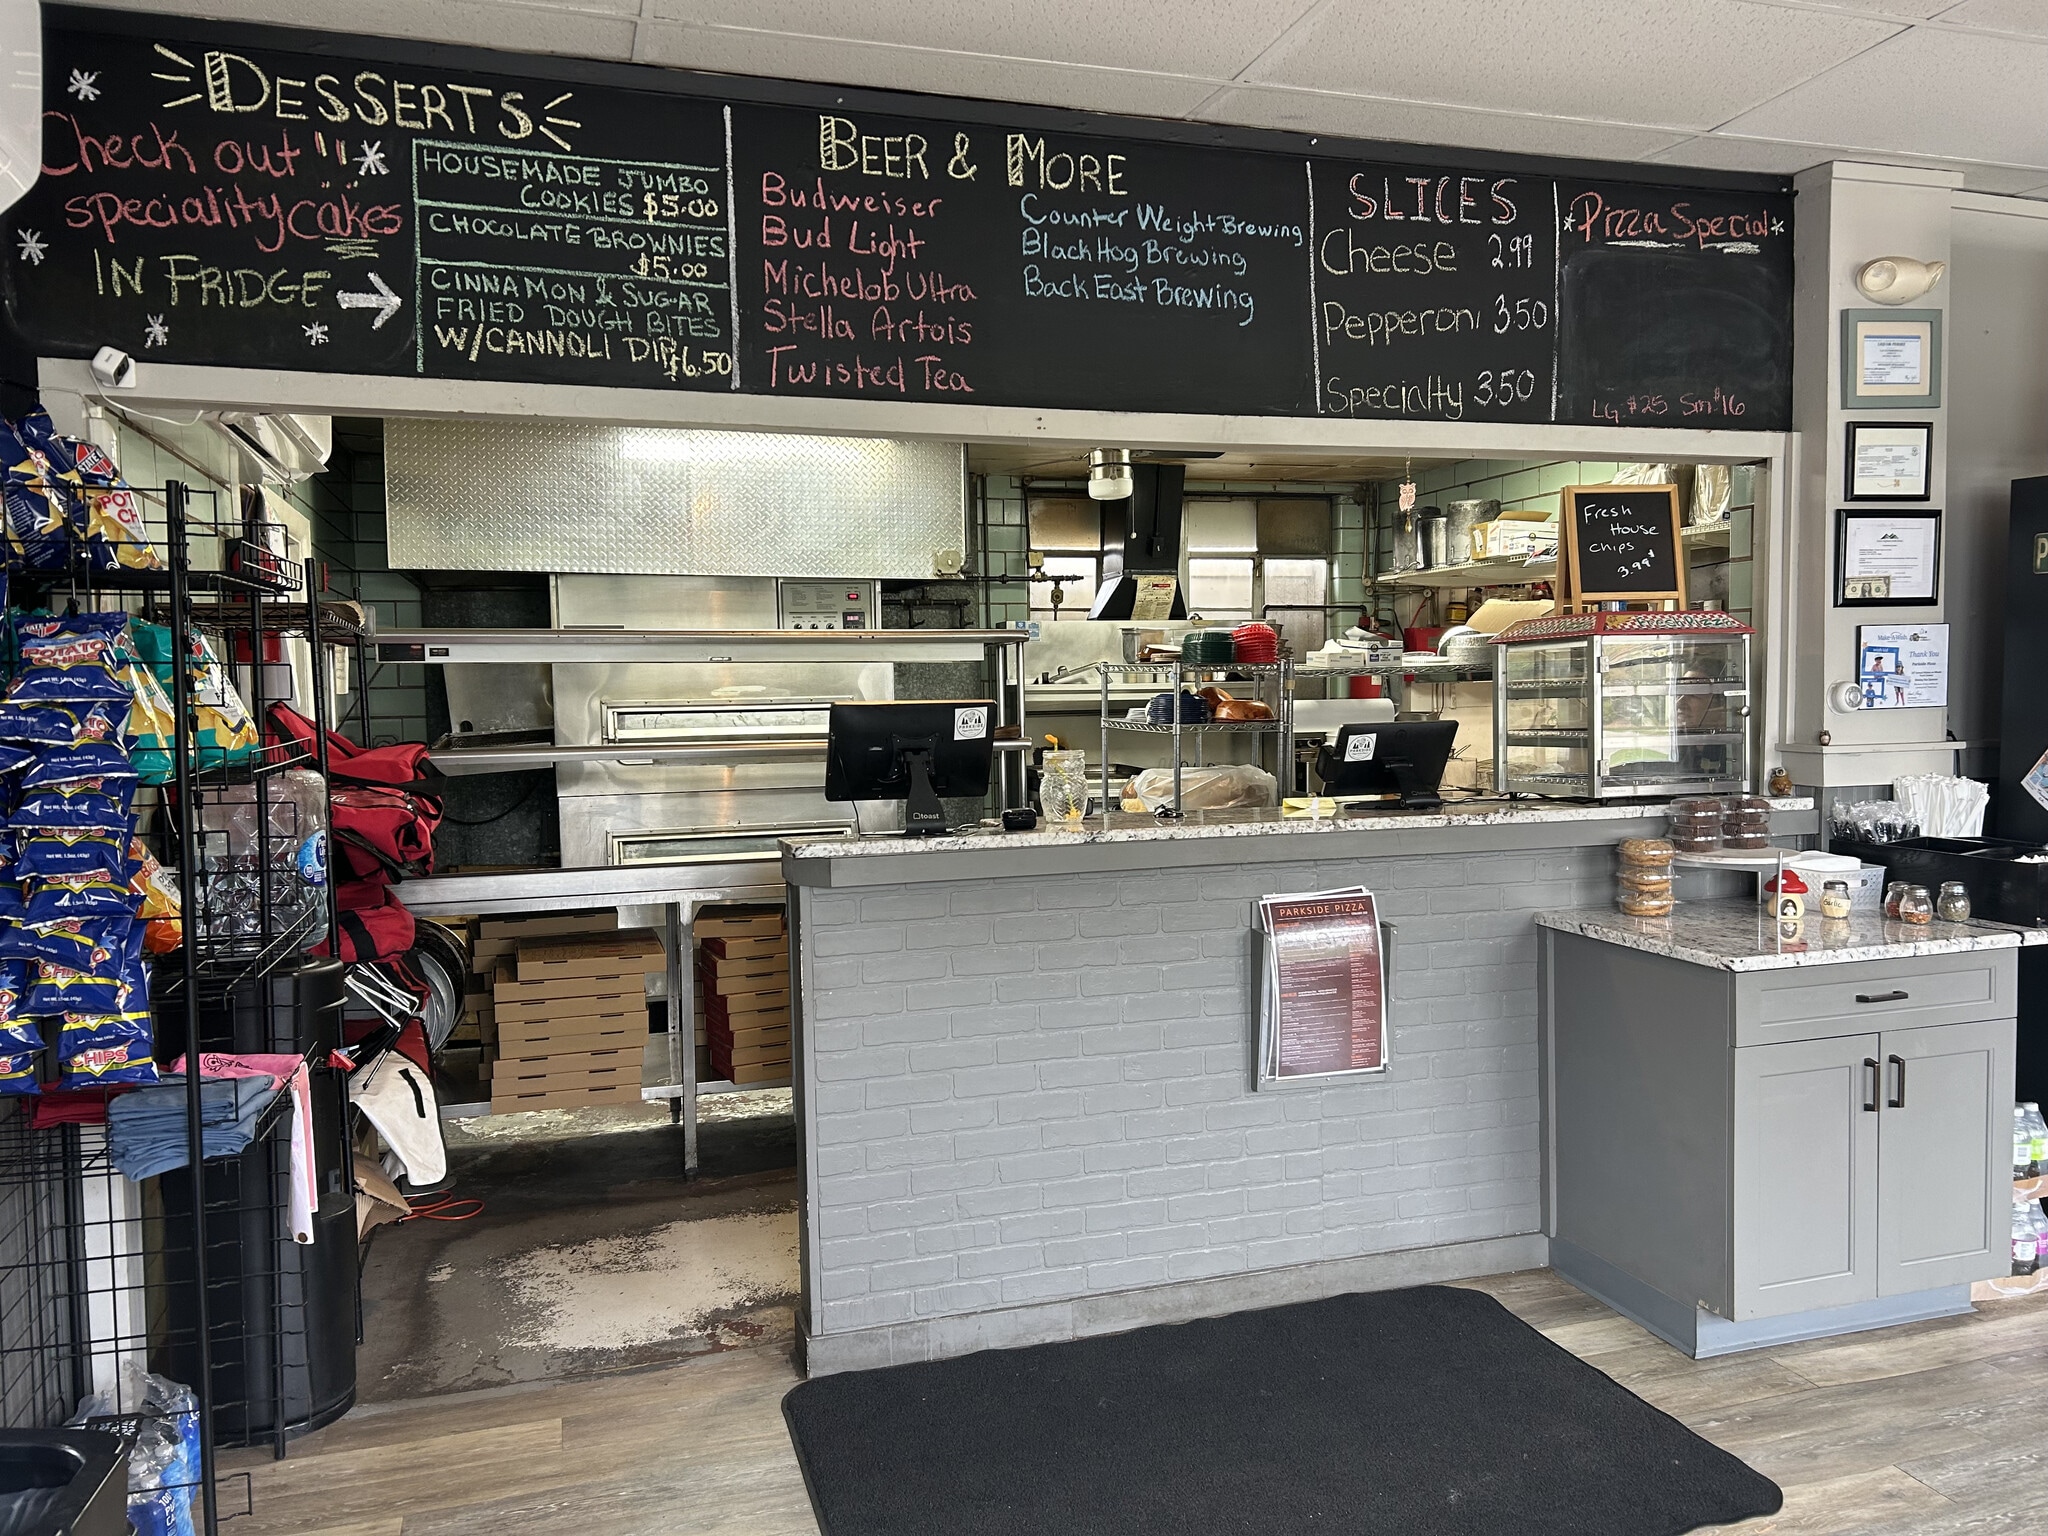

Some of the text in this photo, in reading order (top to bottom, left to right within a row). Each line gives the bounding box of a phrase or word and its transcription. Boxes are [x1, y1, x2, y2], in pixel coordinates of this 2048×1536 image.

[204, 50, 533, 139] DESSERTS
[41, 110, 198, 176] Check
[213, 129, 300, 178] out
[819, 115, 1128, 196] BEER & MORE
[423, 149, 709, 195] HOUSEMADE JUMBO
[762, 172, 943, 217] Budweiser
[65, 182, 285, 253] speciality
[520, 184, 720, 224] COOKIES $5.00
[1020, 193, 1128, 229] Counter
[1217, 215, 1303, 247] Brewing
[1348, 172, 1517, 224] SLICES
[1570, 192, 1666, 242] Pizza
[429, 212, 725, 258] CHOCOLATE BROWNIES
[763, 215, 926, 276] Bud Light
[1022, 227, 1247, 275] Black Hog Brewing
[1320, 229, 1534, 276] Cheese 2.99
[94, 248, 331, 308] IN FRIDGE
[630, 253, 707, 278] $5.00
[764, 258, 977, 304] Michelob Ultra
[430, 268, 712, 315] CINNAMON & SUGAR
[1023, 264, 1253, 326] Back East Brewing
[436, 298, 720, 339] FRIED DOUGH BITES
[764, 299, 973, 344] Stella Artois
[1324, 295, 1548, 345] Pepperoni 3.50
[434, 323, 611, 363] W/CANNOLI
[766, 345, 975, 392] Twisted Tea
[1474, 369, 1535, 406] 3.50
[1584, 504, 1632, 524] Fresh
[1610, 523, 1659, 536] House
[23, 639, 105, 659] POTATO
[32, 652, 99, 665] CHIPS
[1279, 902, 1365, 918] PARKSIDE PIZZA
